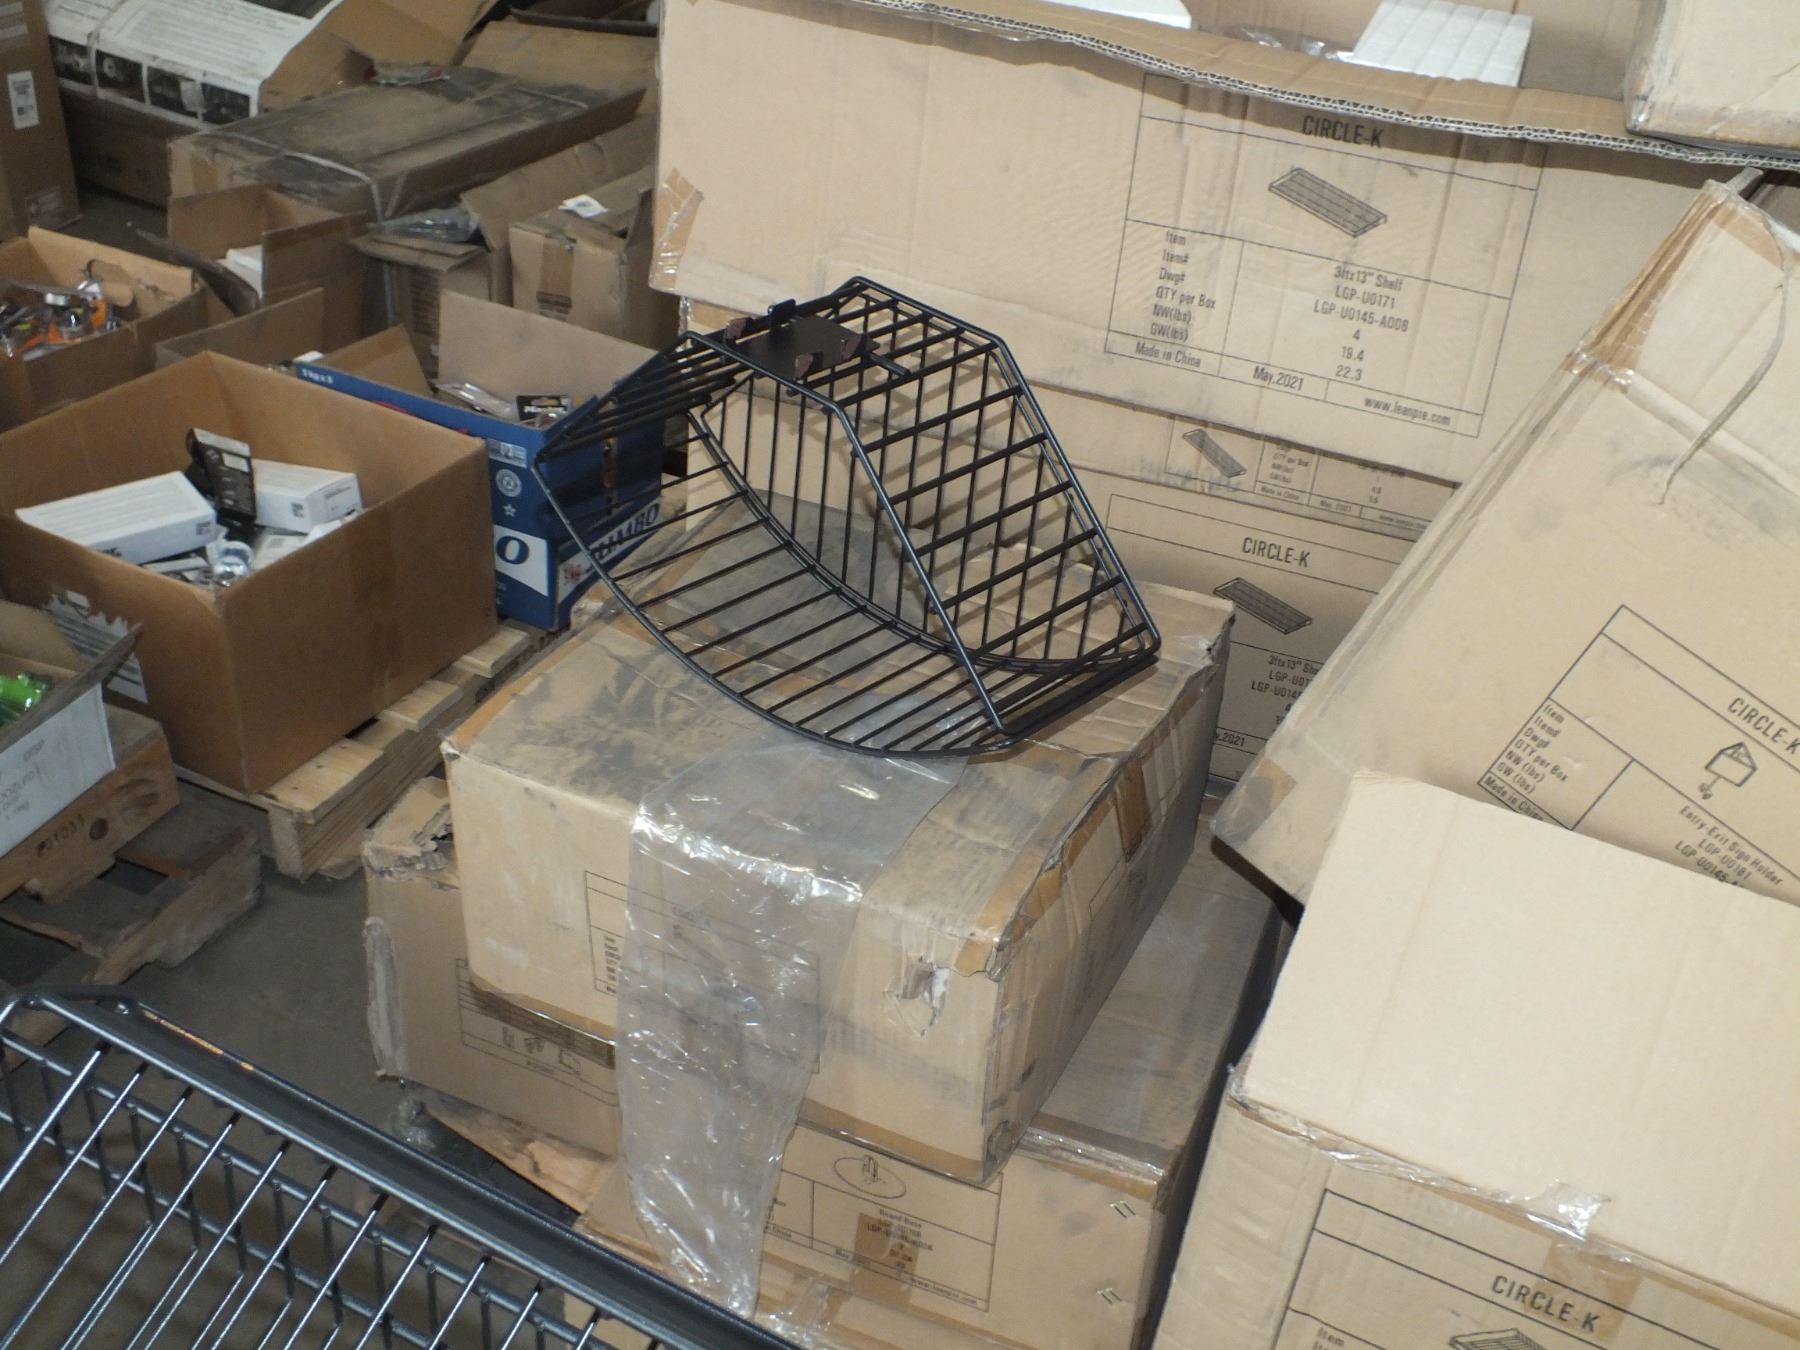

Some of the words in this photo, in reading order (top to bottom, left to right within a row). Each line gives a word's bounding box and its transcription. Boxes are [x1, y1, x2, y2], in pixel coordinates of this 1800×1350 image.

[1302, 114, 1385, 148] CIRCLE-K
[1166, 231, 1187, 246] Item
[1162, 249, 1190, 264] Item#
[1375, 273, 1403, 292] Shelf
[1155, 286, 1178, 301] QTY
[1178, 293, 1196, 307] per
[1197, 293, 1217, 309] Box
[1334, 285, 1396, 310] LGP-U0171
[1352, 328, 1361, 341] 4
[1135, 341, 1160, 359] Made
[1162, 350, 1173, 362] in
[1174, 349, 1202, 368] China
[1334, 364, 1363, 382] 22.3
[1242, 537, 1311, 569] CIRCLE-K
[1268, 669, 1313, 688] LGP-U01
[1543, 704, 1565, 724] Item
[1727, 697, 1800, 755] CIRCLE-K
[1215, 731, 1246, 748] .2021
[1550, 764, 1569, 783] Box
[1484, 776, 1509, 798] Made
[1674, 840, 1745, 889] LGP-U0145-
[1727, 841, 1752, 864] Sign
[1750, 858, 1784, 886] Holder
[1491, 1274, 1601, 1334] CIRCLE-K
